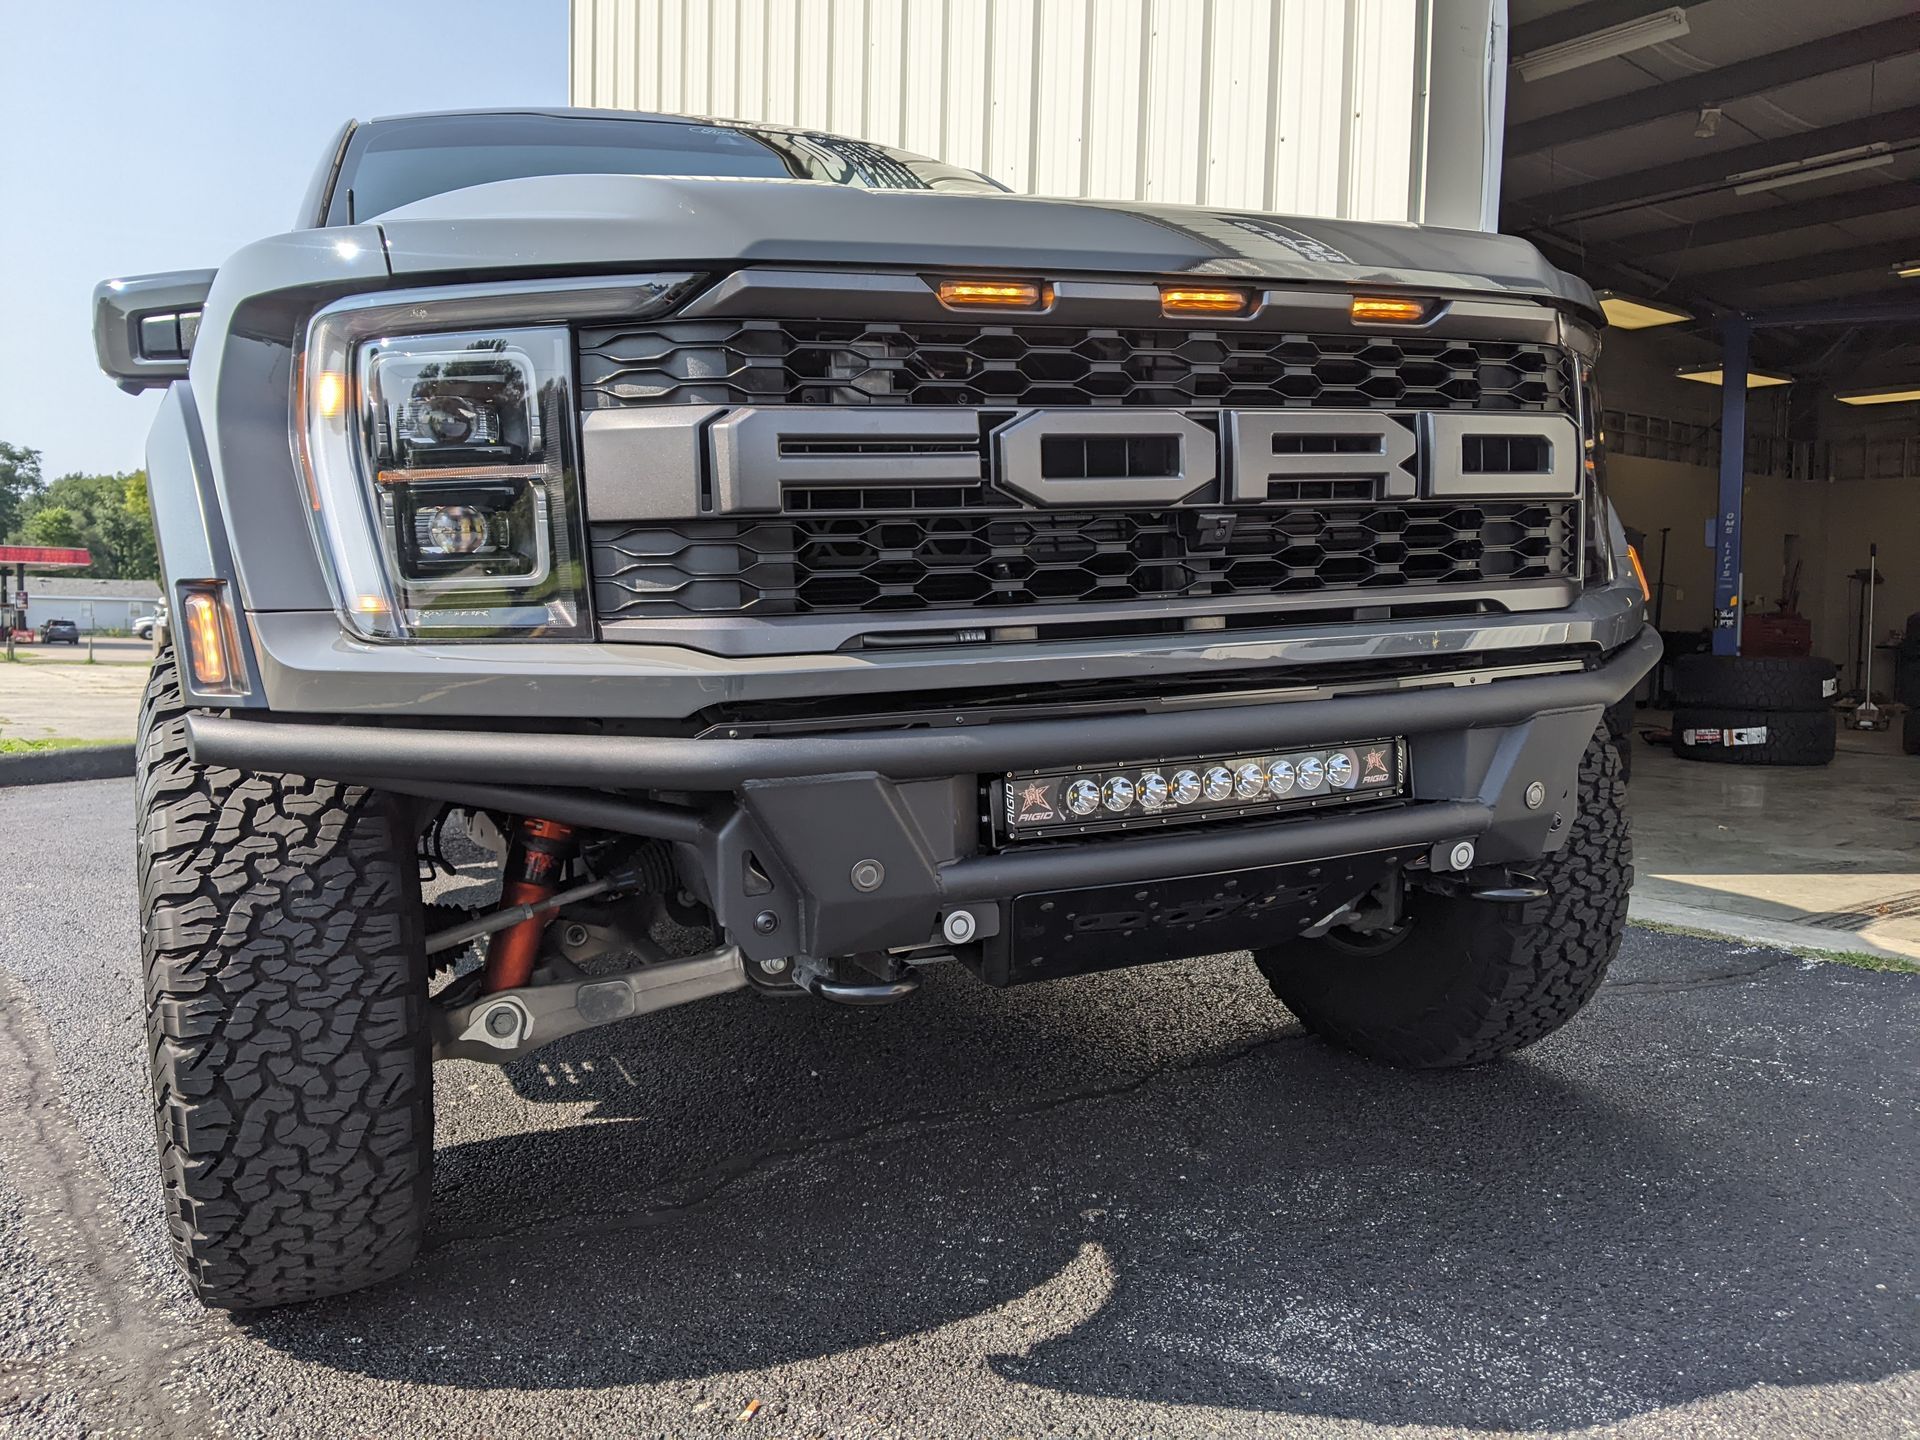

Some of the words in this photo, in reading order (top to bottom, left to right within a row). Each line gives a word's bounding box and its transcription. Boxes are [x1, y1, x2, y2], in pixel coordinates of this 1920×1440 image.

[713, 407, 1577, 514] FORD
[1722, 541, 1731, 577] LIFTS
[1362, 773, 1389, 784] RIGID
[1006, 783, 1015, 825] RIGID
[1018, 811, 1055, 822] RIGID
